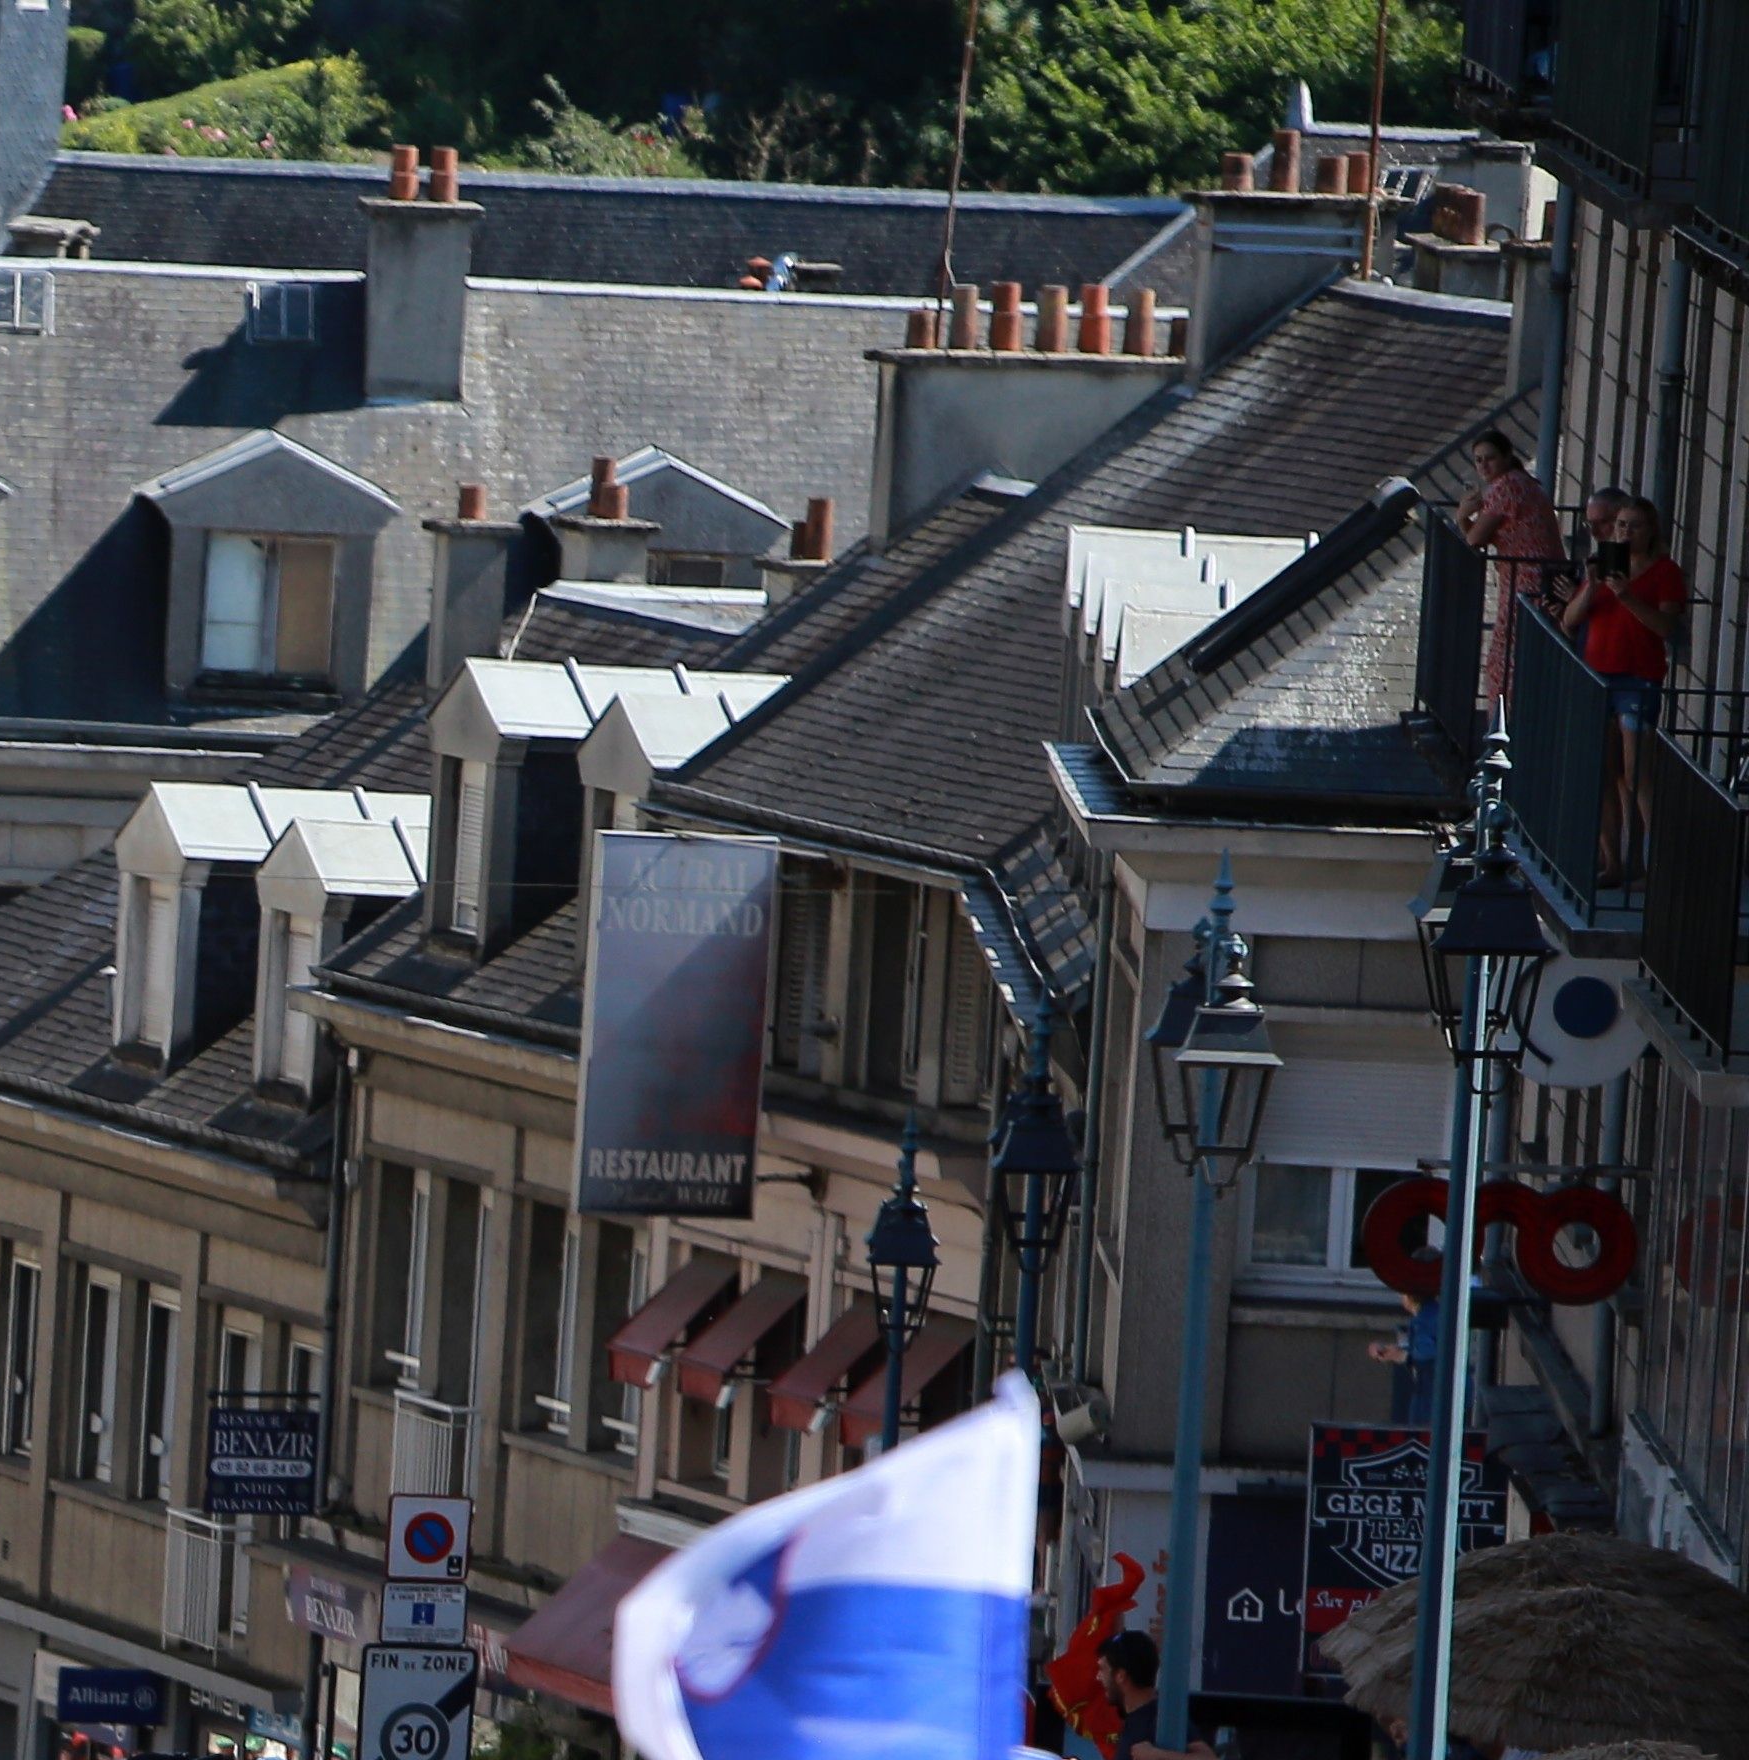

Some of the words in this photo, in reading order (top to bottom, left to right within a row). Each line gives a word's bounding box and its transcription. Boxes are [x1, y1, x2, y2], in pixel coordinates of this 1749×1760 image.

[606, 896, 764, 938] NORMAND
[588, 1148, 747, 1184] RESTAURANT
[213, 1430, 314, 1457] BENAZIR
[234, 1481, 287, 1495] INDIEN
[304, 1594, 357, 1639] BENAZIR
[370, 1653, 400, 1670] FIN
[422, 1655, 469, 1672] ZONE
[68, 1686, 131, 1707] Allianz
[394, 1724, 437, 1755] 30
